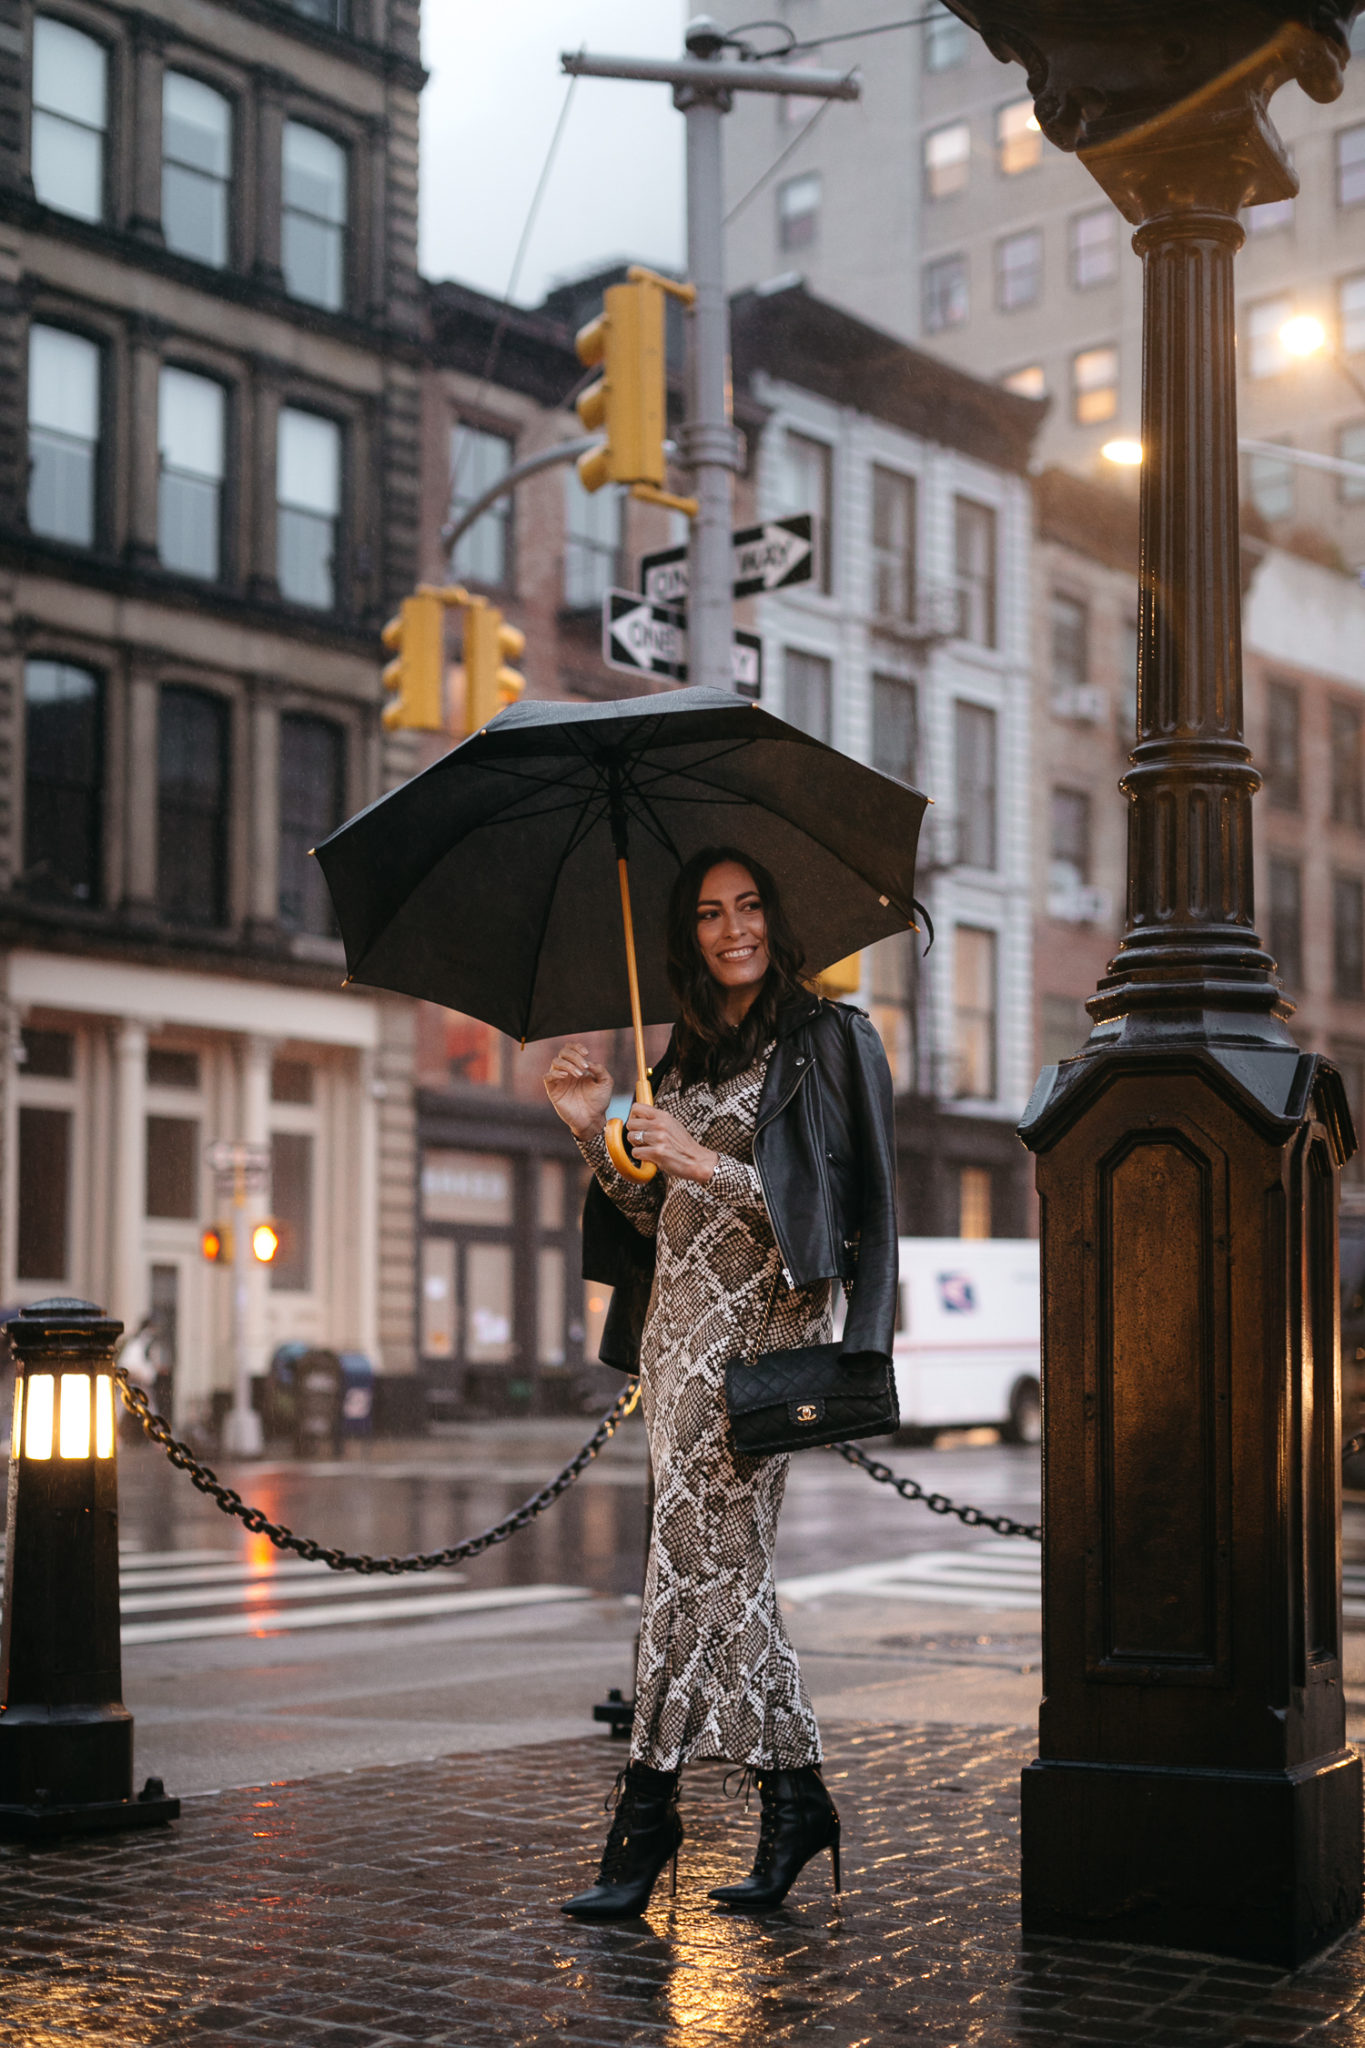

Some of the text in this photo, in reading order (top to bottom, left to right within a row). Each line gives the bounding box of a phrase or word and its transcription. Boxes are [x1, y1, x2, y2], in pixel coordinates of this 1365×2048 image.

[653, 542, 787, 597] ON WAY
[629, 621, 676, 656] ONE
